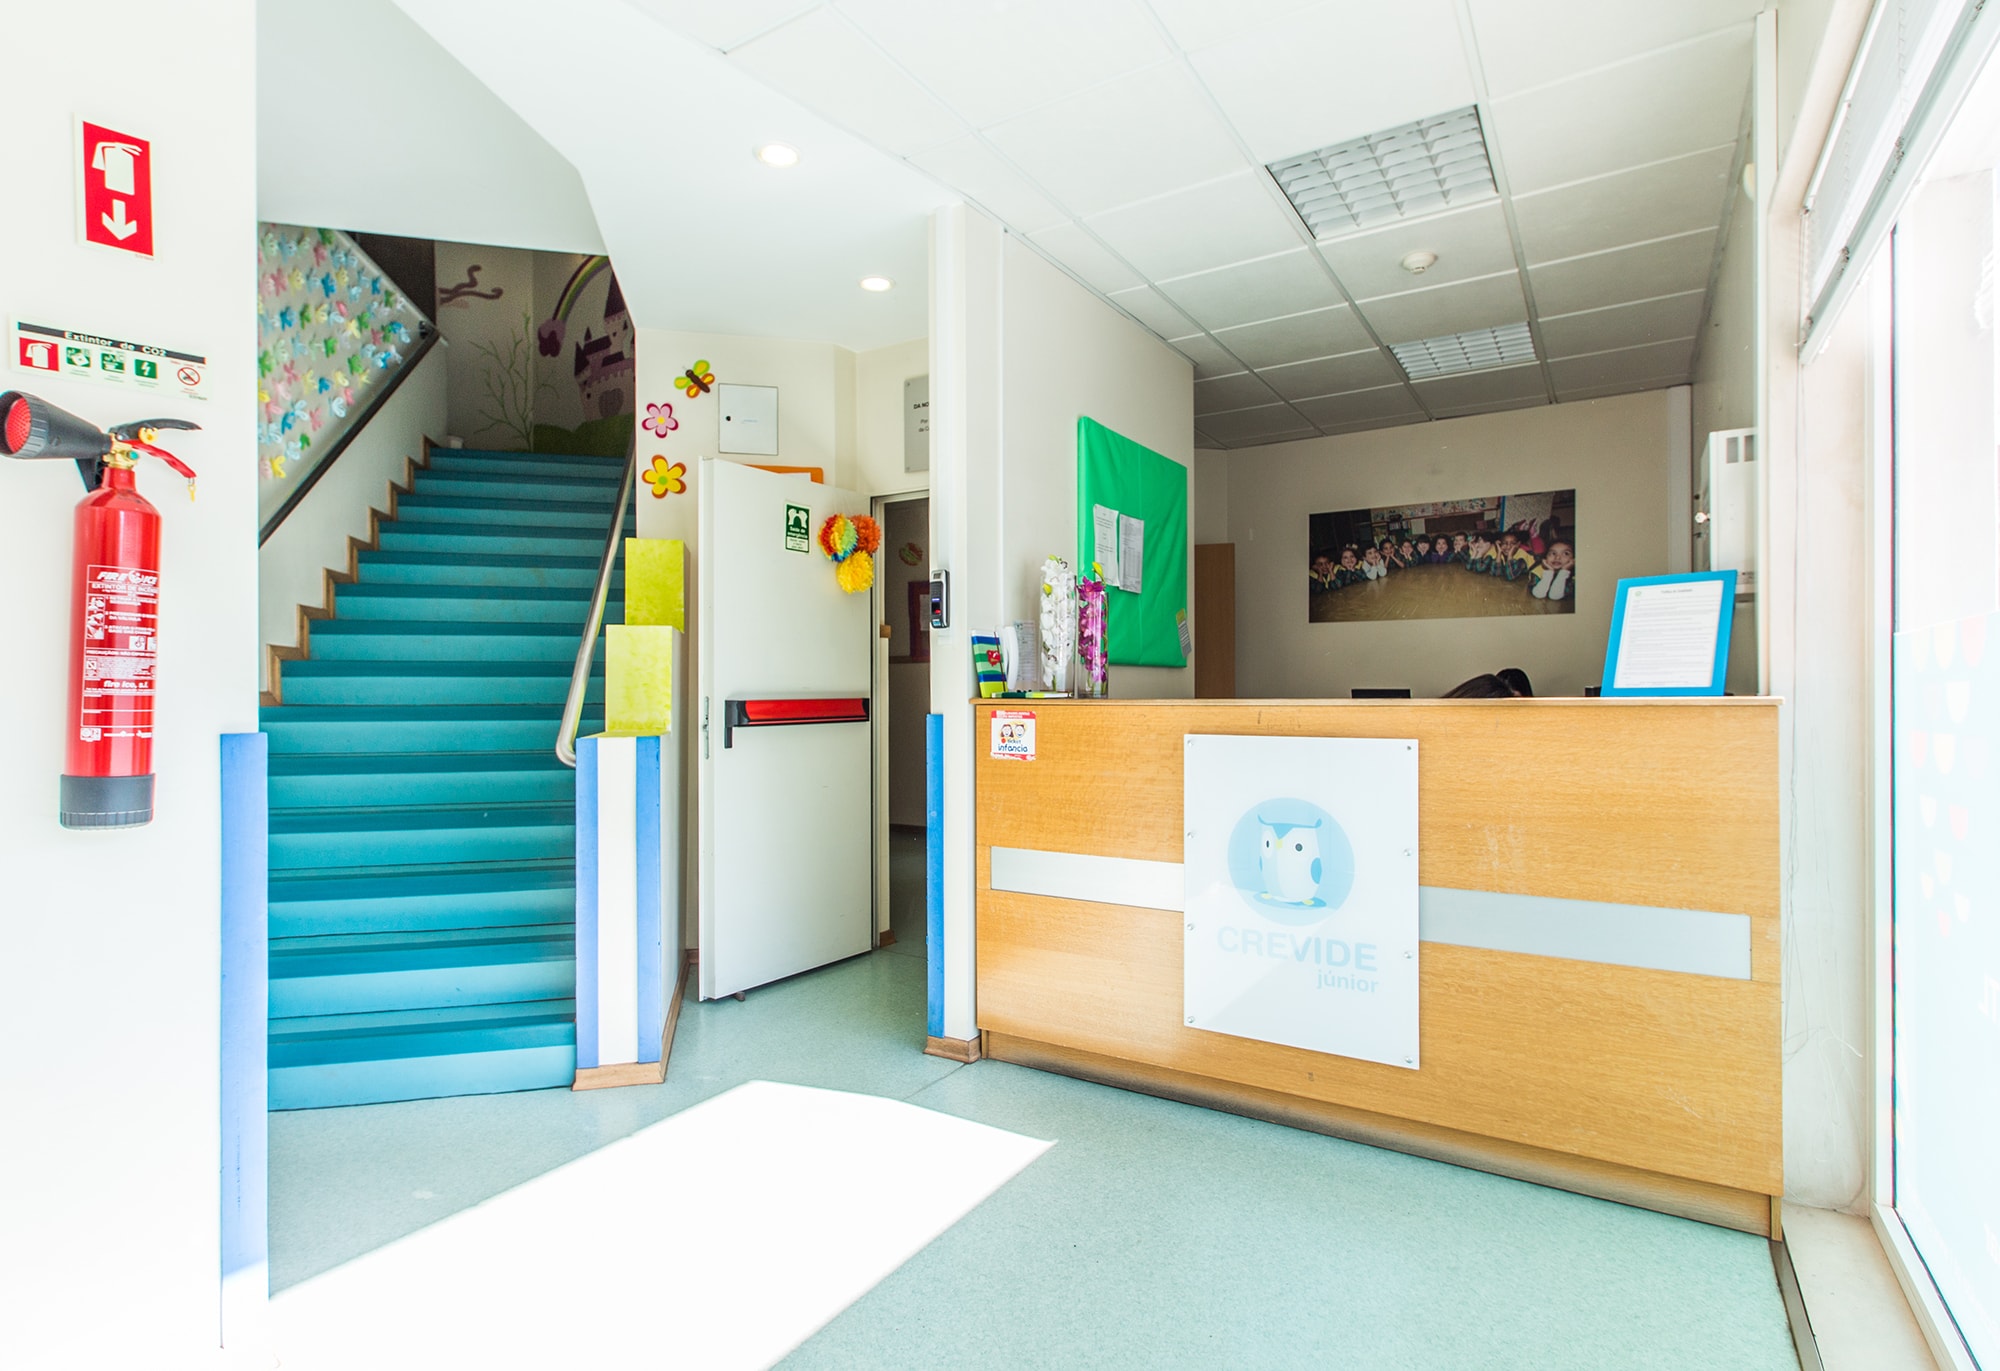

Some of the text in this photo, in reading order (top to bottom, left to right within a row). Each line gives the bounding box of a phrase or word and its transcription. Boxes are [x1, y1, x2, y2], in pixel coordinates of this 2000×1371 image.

[65, 331, 113, 347] Extintor
[120, 342, 135, 351] de
[142, 346, 167, 357] CO2
[91, 582, 127, 591] EXTINTOR
[97, 571, 158, 585] FIRE ICE
[103, 680, 120, 688] fire
[1217, 926, 1378, 971] CREVIDE
[1316, 968, 1379, 993] júnior
